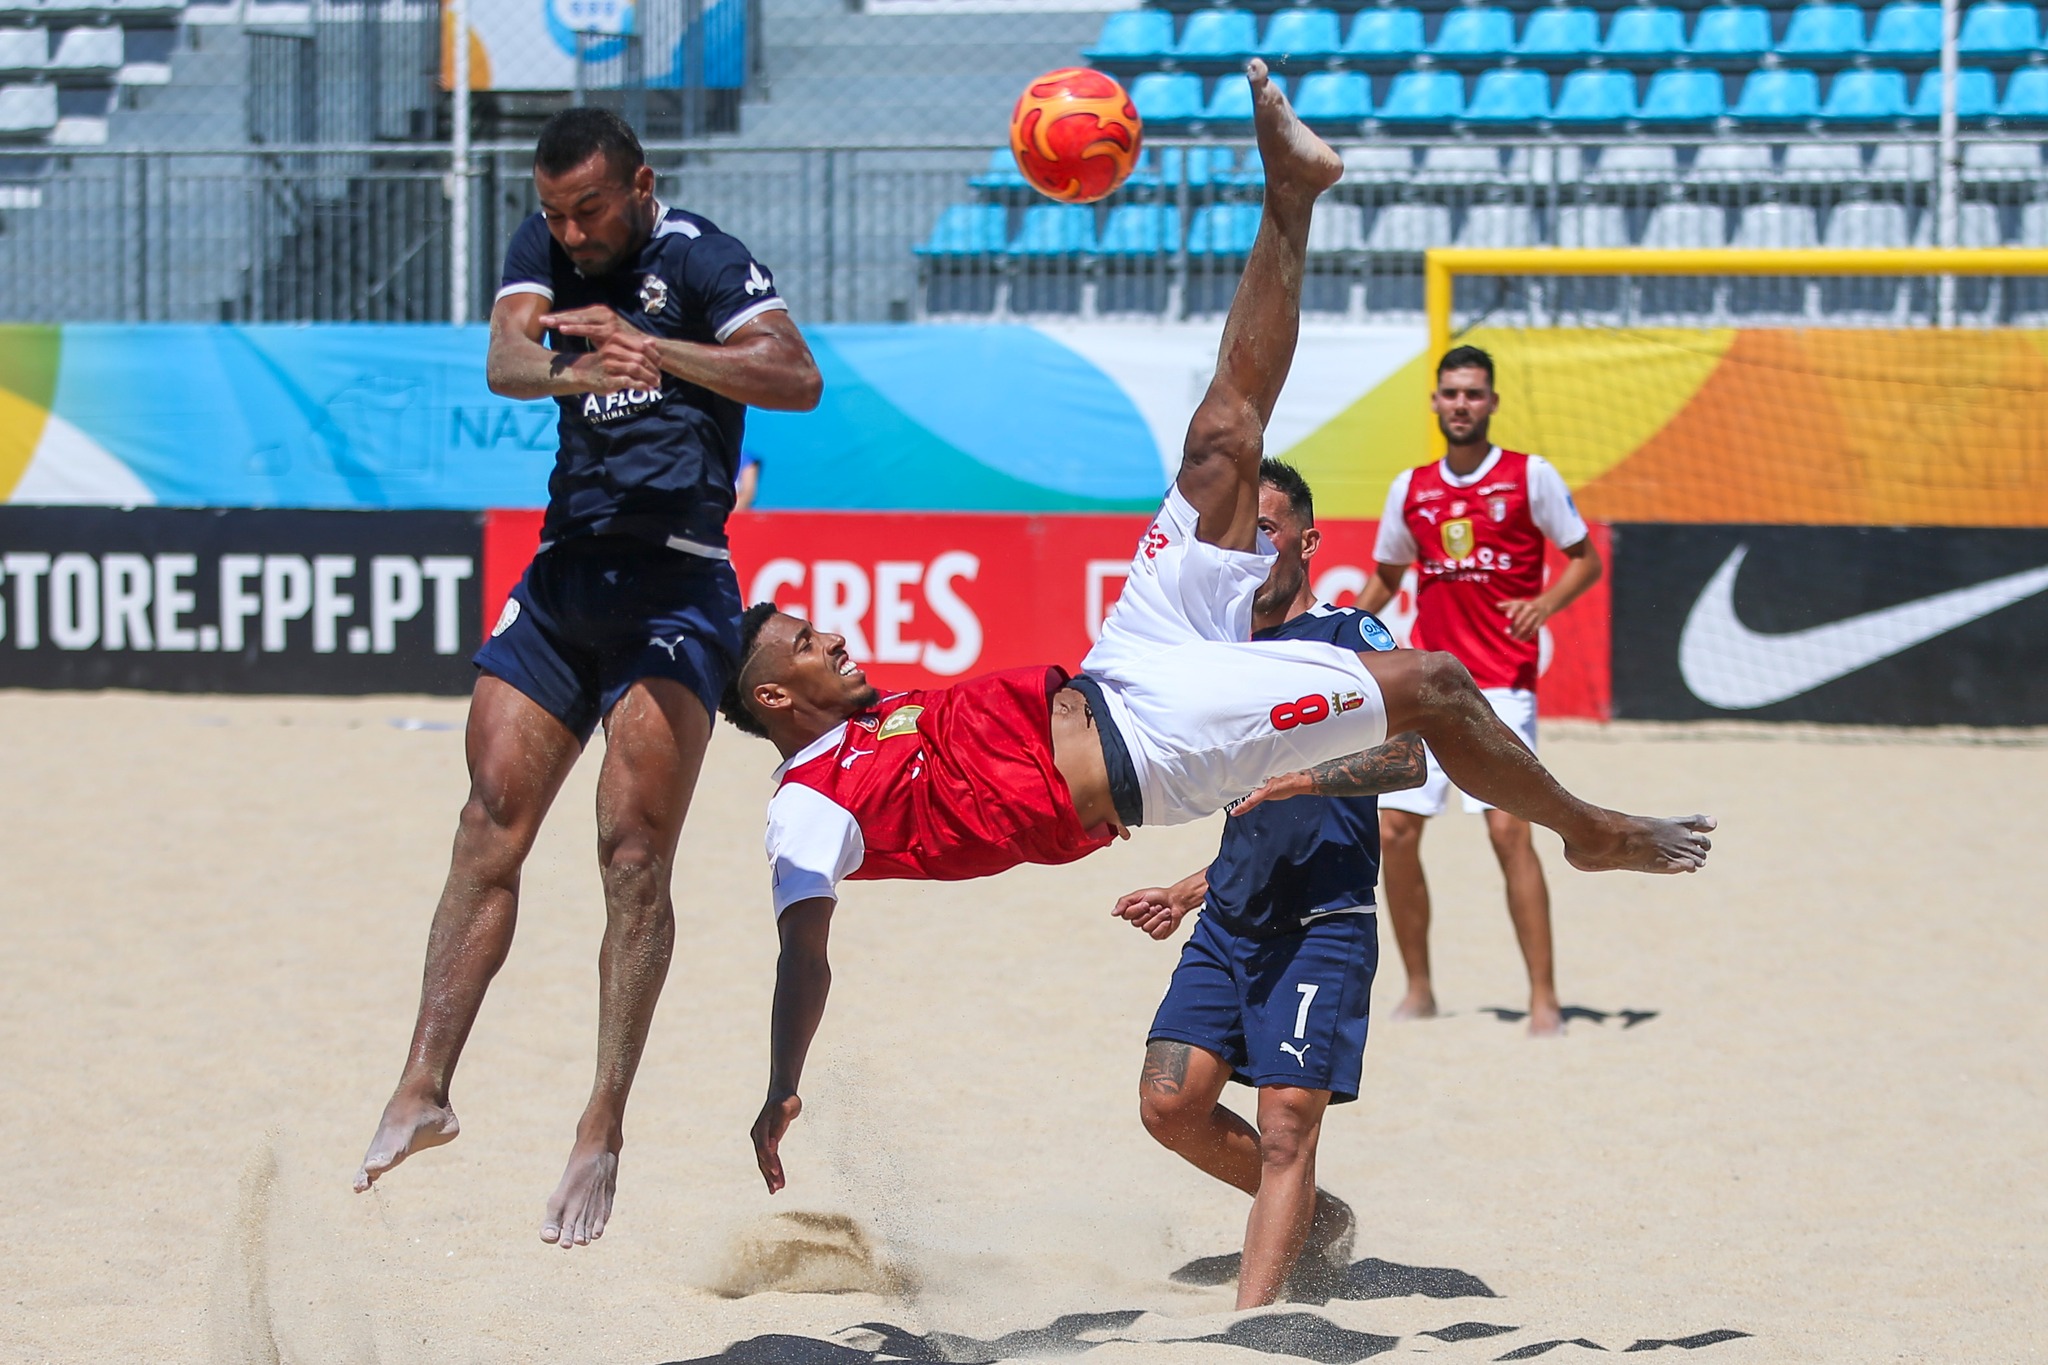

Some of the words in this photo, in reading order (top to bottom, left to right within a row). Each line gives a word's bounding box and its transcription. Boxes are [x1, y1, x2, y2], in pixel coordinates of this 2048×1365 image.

[584, 392, 601, 417] A
[602, 408, 626, 422] ALMA
[0, 551, 474, 655] TORE.FPF.PT
[1270, 693, 1330, 731] 8
[1293, 983, 1320, 1040] 7
